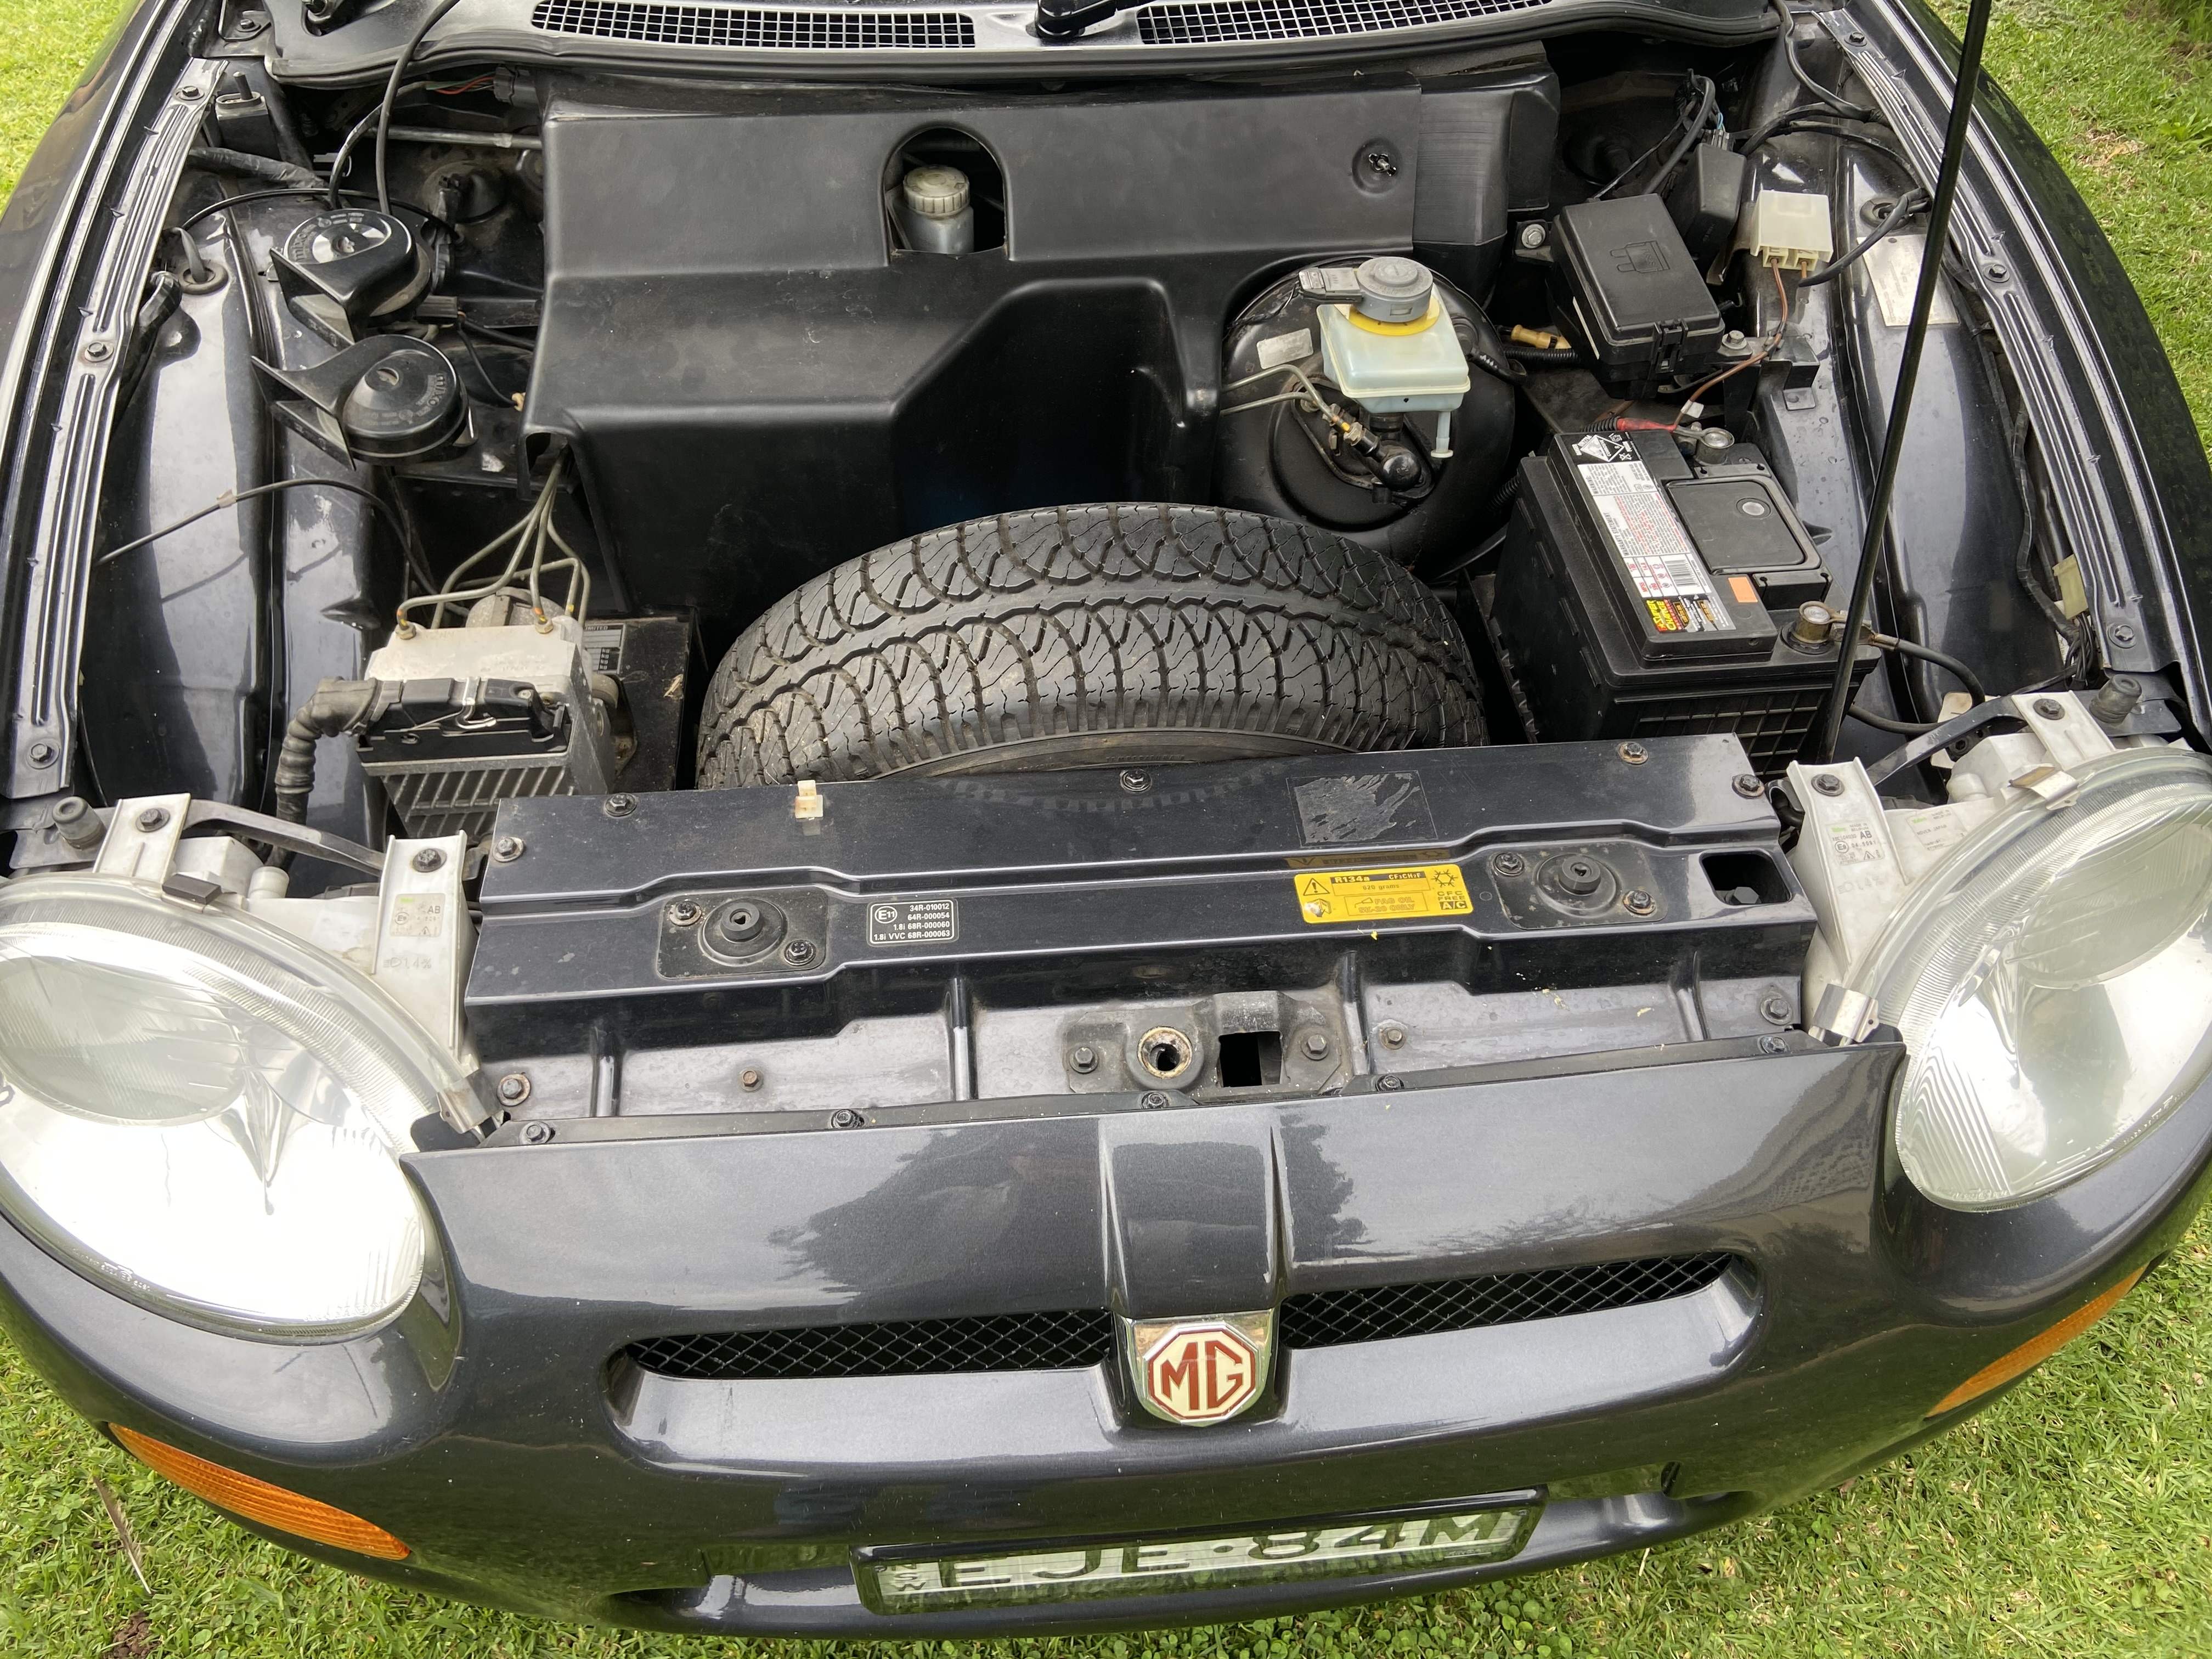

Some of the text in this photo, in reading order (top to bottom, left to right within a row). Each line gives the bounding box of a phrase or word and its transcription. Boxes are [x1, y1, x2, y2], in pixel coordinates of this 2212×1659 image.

[1603, 512, 1618, 533] STATEMENT
[1615, 535, 1629, 555] WARRANTY
[1646, 600, 1663, 623] SUPER
[1656, 601, 1677, 630] CHARGE
[1860, 831, 1872, 839] AB
[1335, 876, 1370, 884] R134a
[427, 905, 441, 914] AB
[910, 903, 950, 911] 34R-010012
[1442, 901, 1466, 910] A/C
[878, 910, 895, 921] E11
[907, 912, 950, 921] 64R-000054
[907, 921, 950, 930] 68R-000060
[888, 932, 906, 940] VVC
[907, 930, 950, 939] 68R-000063
[1160, 1340, 1243, 1411] MG
